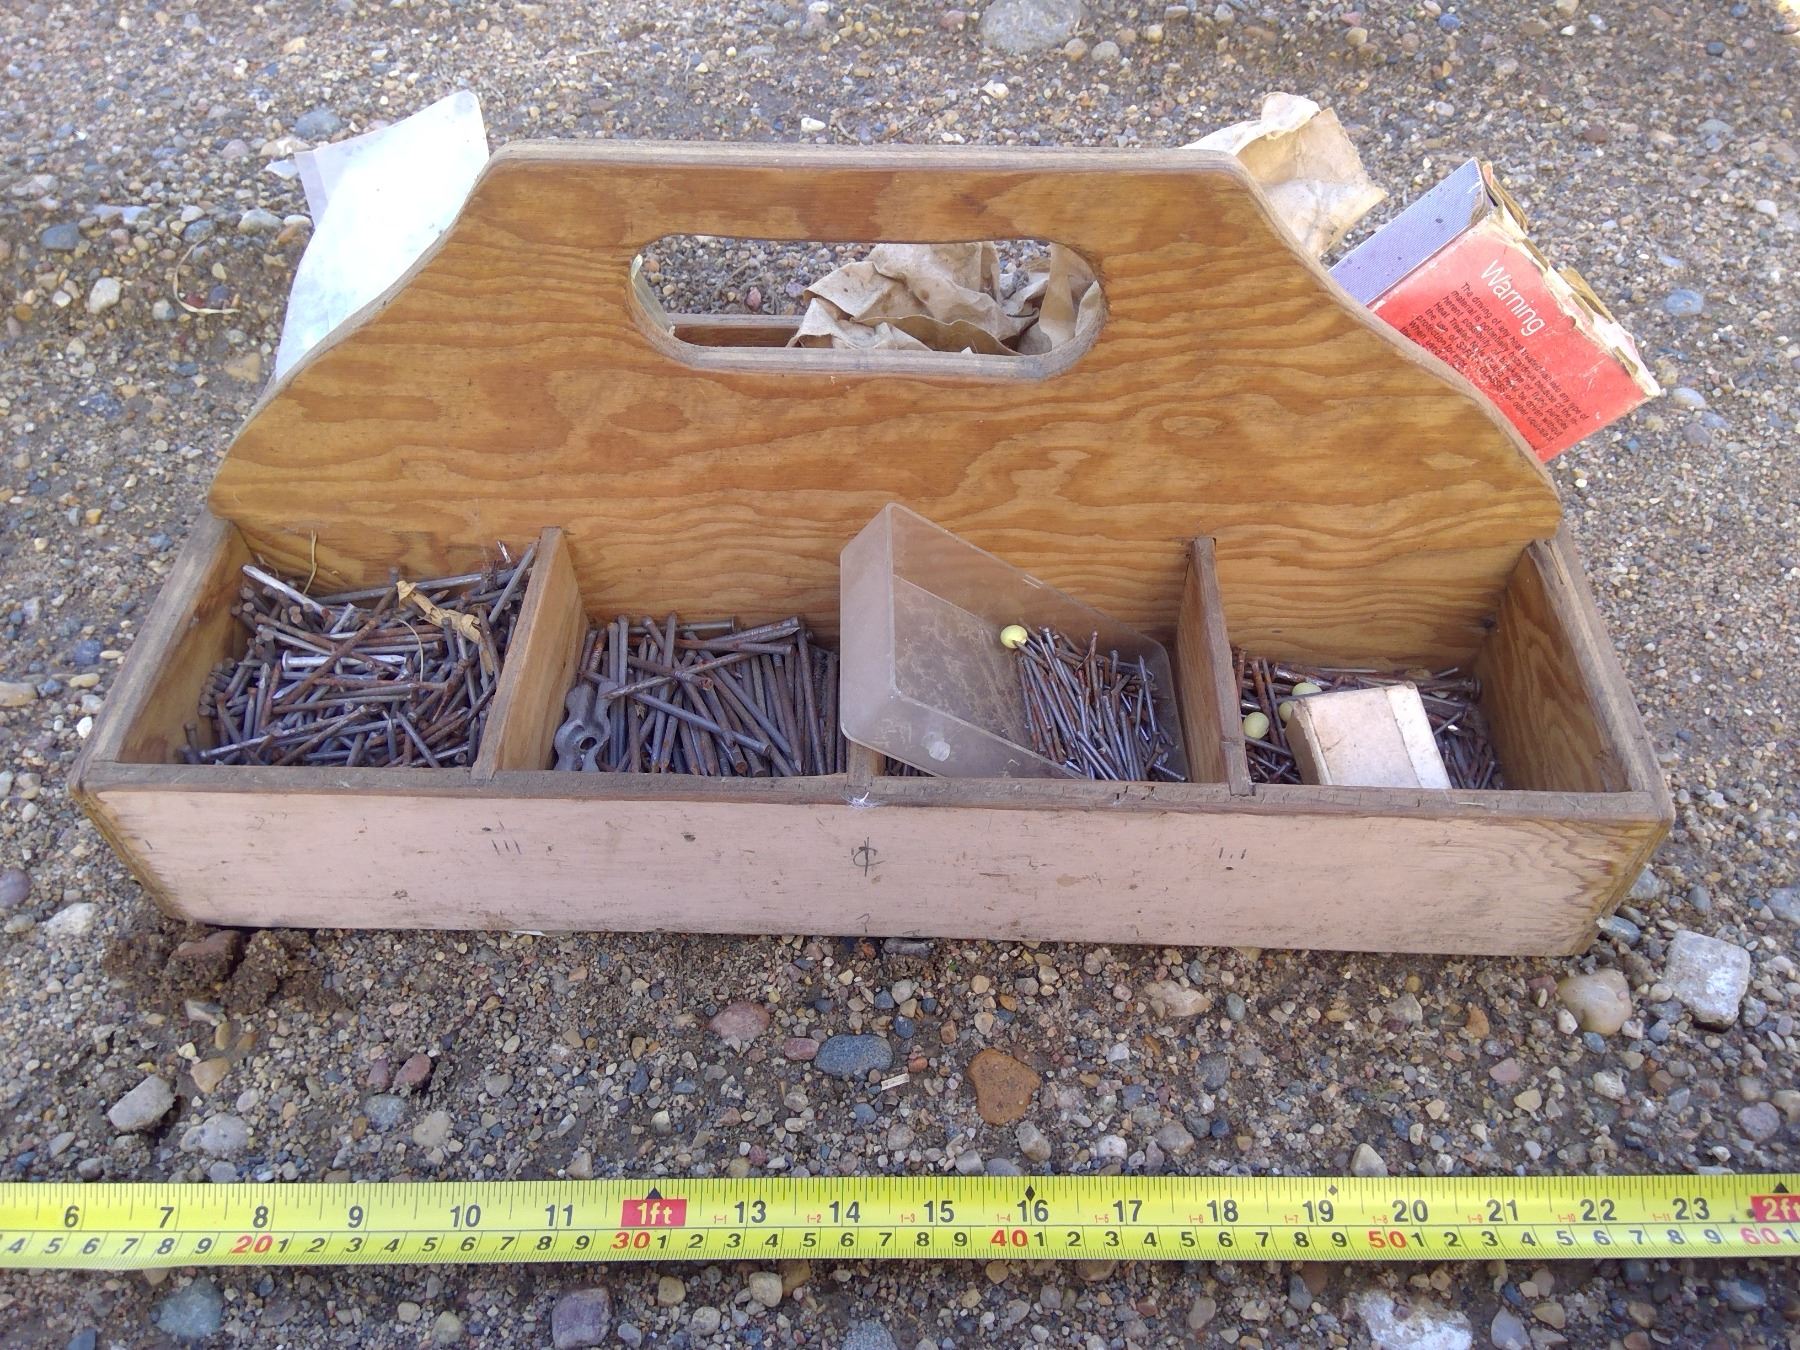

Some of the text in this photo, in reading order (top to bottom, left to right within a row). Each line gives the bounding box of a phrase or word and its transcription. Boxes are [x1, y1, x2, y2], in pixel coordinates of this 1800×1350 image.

[1443, 296, 1463, 317] herent
[1480, 260, 1546, 337] Warning
[1409, 320, 1426, 340] When
[1425, 340, 1442, 356] used
[1416, 315, 1446, 345] protection
[1444, 344, 1456, 355] for
[1425, 308, 1437, 320] the
[1436, 321, 1449, 334] use
[1448, 334, 1458, 343] of
[1513, 402, 1528, 416] other
[1433, 302, 1450, 319] Heat
[1449, 318, 1471, 341] Treated
[1526, 401, 1543, 417] driven
[1451, 290, 1476, 315] material
[1561, 408, 1571, 418] the
[1461, 282, 1473, 297] The
[1472, 297, 1492, 319] driving
[1491, 318, 1502, 326] of
[1498, 326, 1511, 338] any
[1559, 393, 1570, 403] any
[1580, 413, 1590, 421] of
[8, 1228, 1796, 1254] 4 5 6 7 8 9 20 1 2 3 4 5 6 7 8 9 30 1 2 3 4 5 6 7 8 9 40 1 2 3 4 5 6 7 8 9 50 1 2 3 4 5 6 7 8 9 60 1
[64, 1206, 80, 1228] 6
[159, 1206, 173, 1228] 7
[253, 1206, 268, 1228] 8
[348, 1206, 364, 1228] 9
[451, 1205, 481, 1228] 10
[545, 1205, 574, 1226] 11
[637, 1204, 673, 1224] 1ft
[734, 1201, 766, 1223] 13
[830, 1201, 860, 1223] 14
[924, 1200, 954, 1222] 15
[1017, 1200, 1048, 1222] 16
[1113, 1200, 1143, 1222] 17
[1208, 1200, 1238, 1222] 18
[1303, 1200, 1334, 1222] 19
[1392, 1200, 1428, 1222] 20
[1486, 1200, 1517, 1222] 21
[1580, 1199, 1617, 1221] 22
[1672, 1199, 1710, 1220] 23
